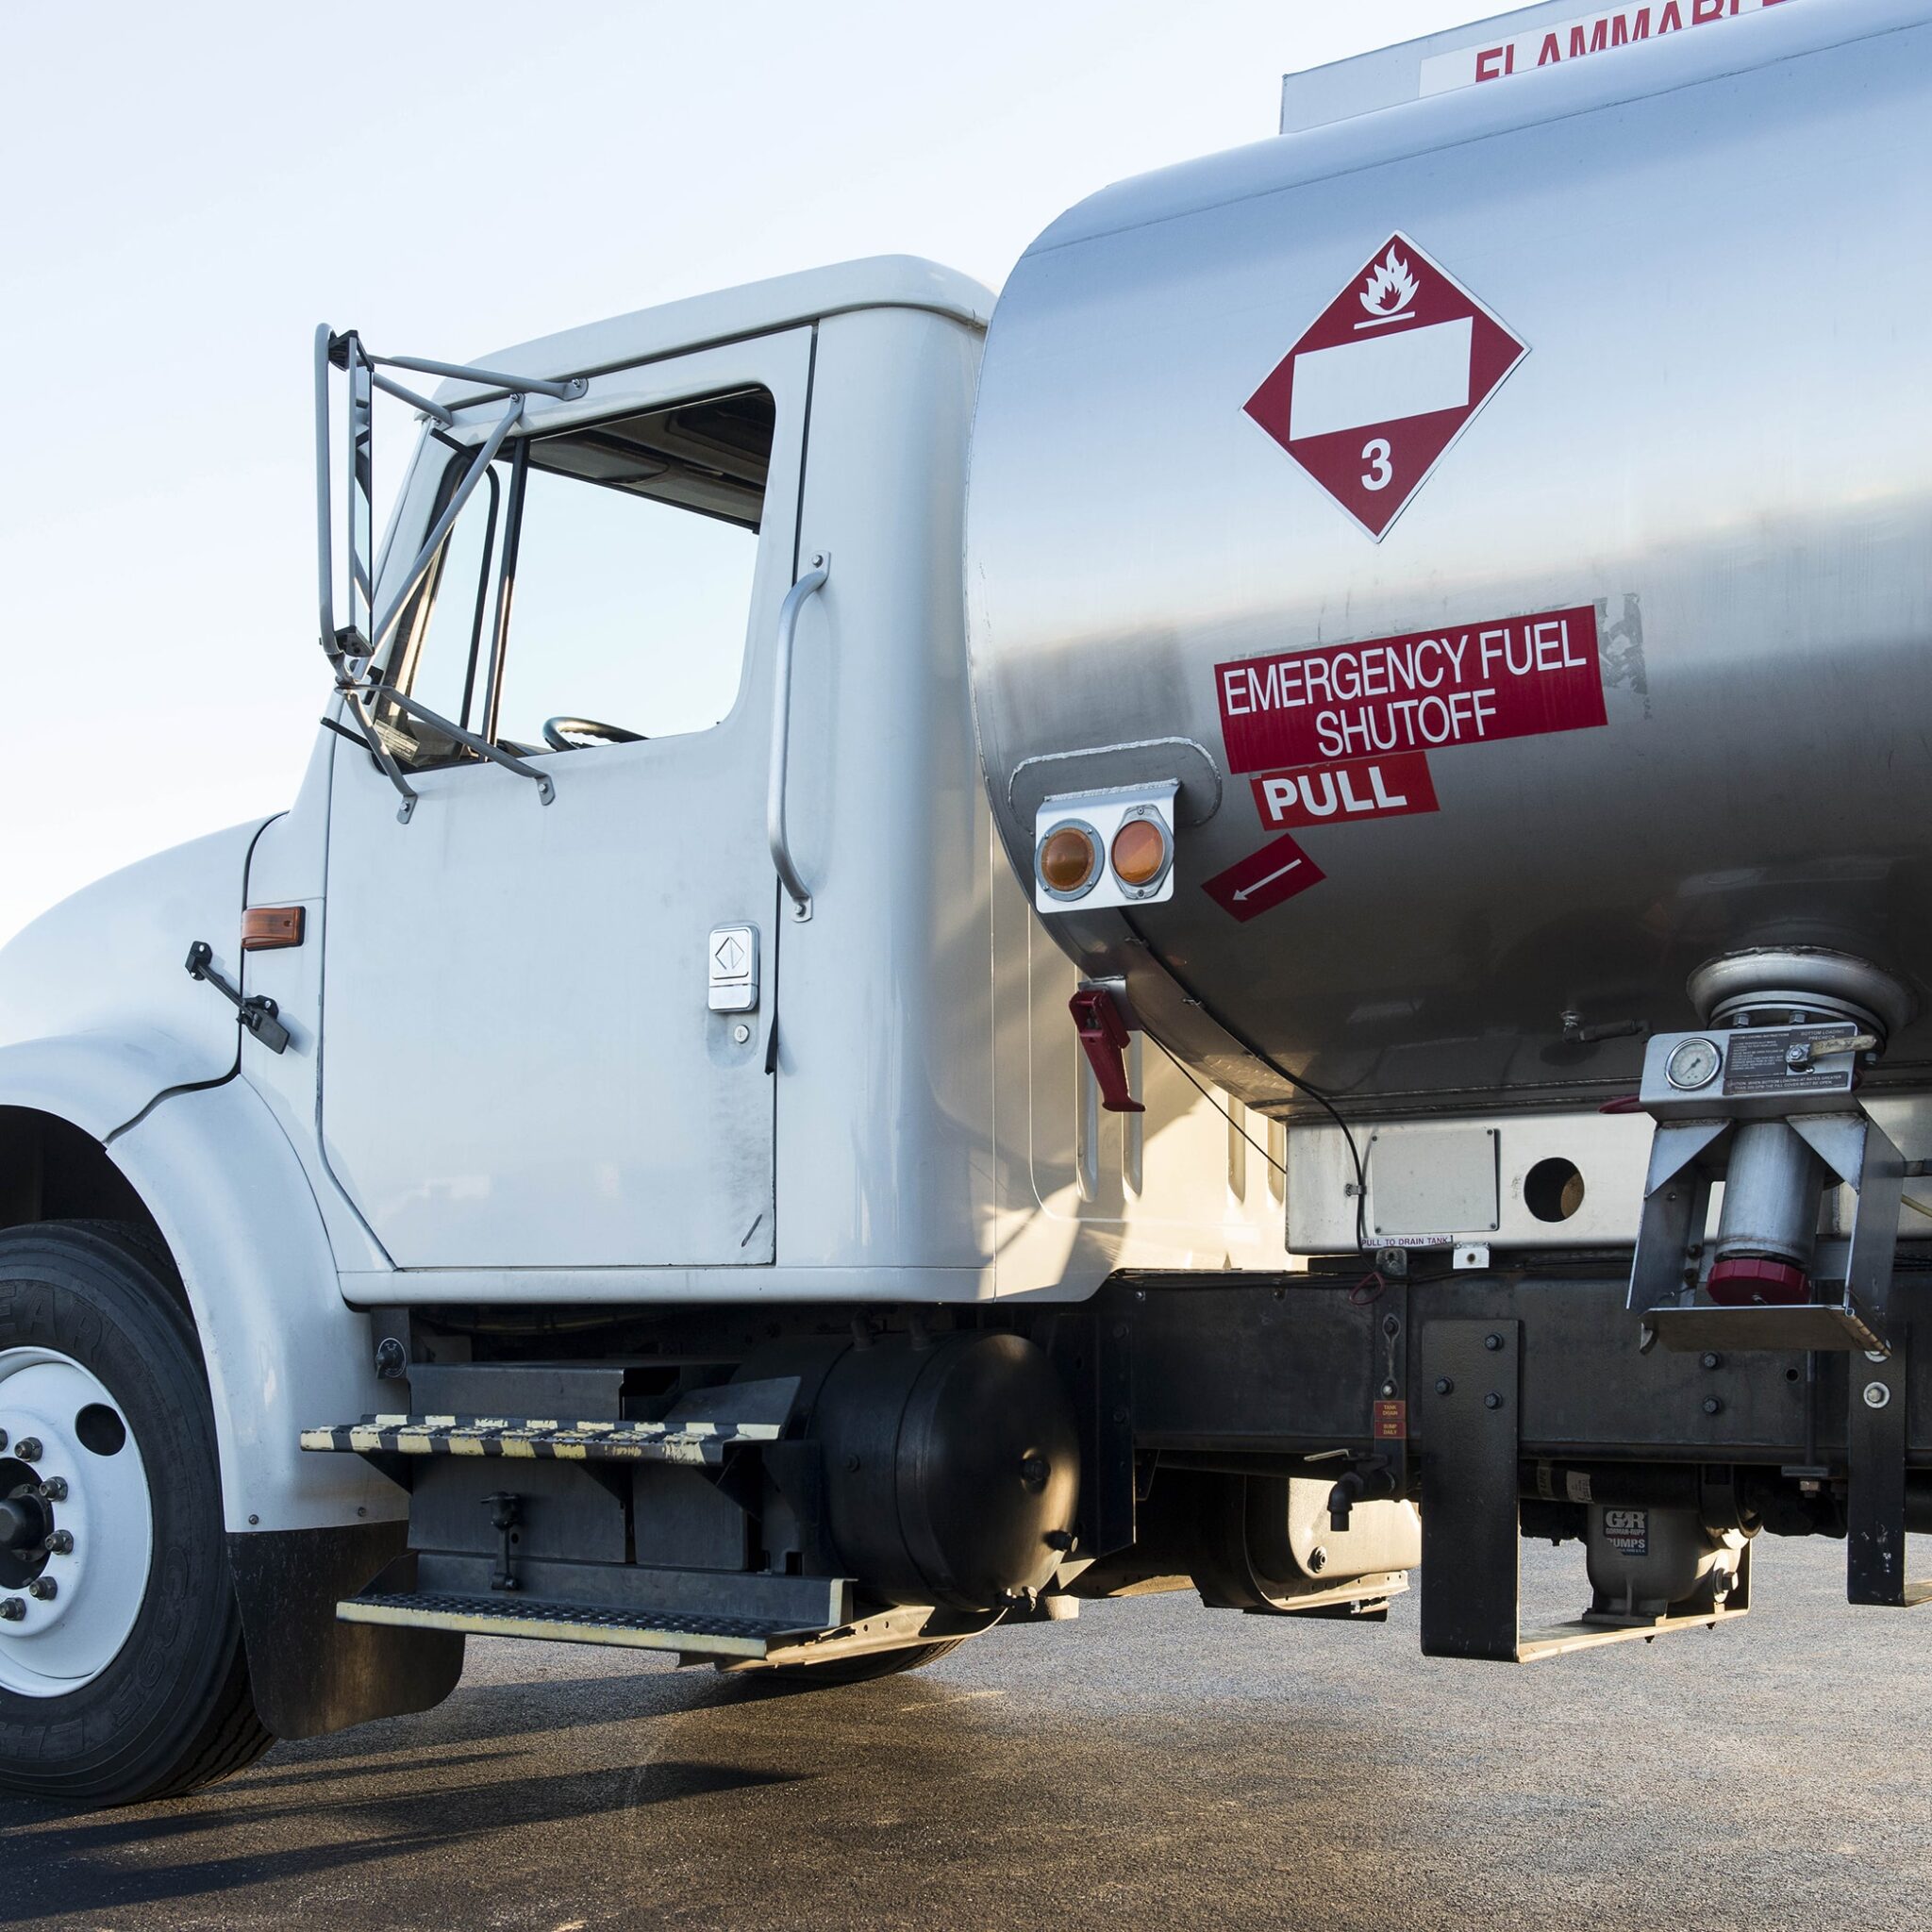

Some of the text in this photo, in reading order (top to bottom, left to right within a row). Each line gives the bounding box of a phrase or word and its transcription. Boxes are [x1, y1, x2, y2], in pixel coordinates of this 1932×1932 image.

[1475, 0, 1790, 83] FLAMMAB
[1361, 438, 1392, 491] 3
[1224, 620, 1586, 715] EMERGENCY FUEL
[1315, 689, 1496, 757] SHUTOFF
[1262, 766, 1407, 821] PULL
[1361, 1238, 1382, 1246] PULL
[1386, 1238, 1396, 1246] TO
